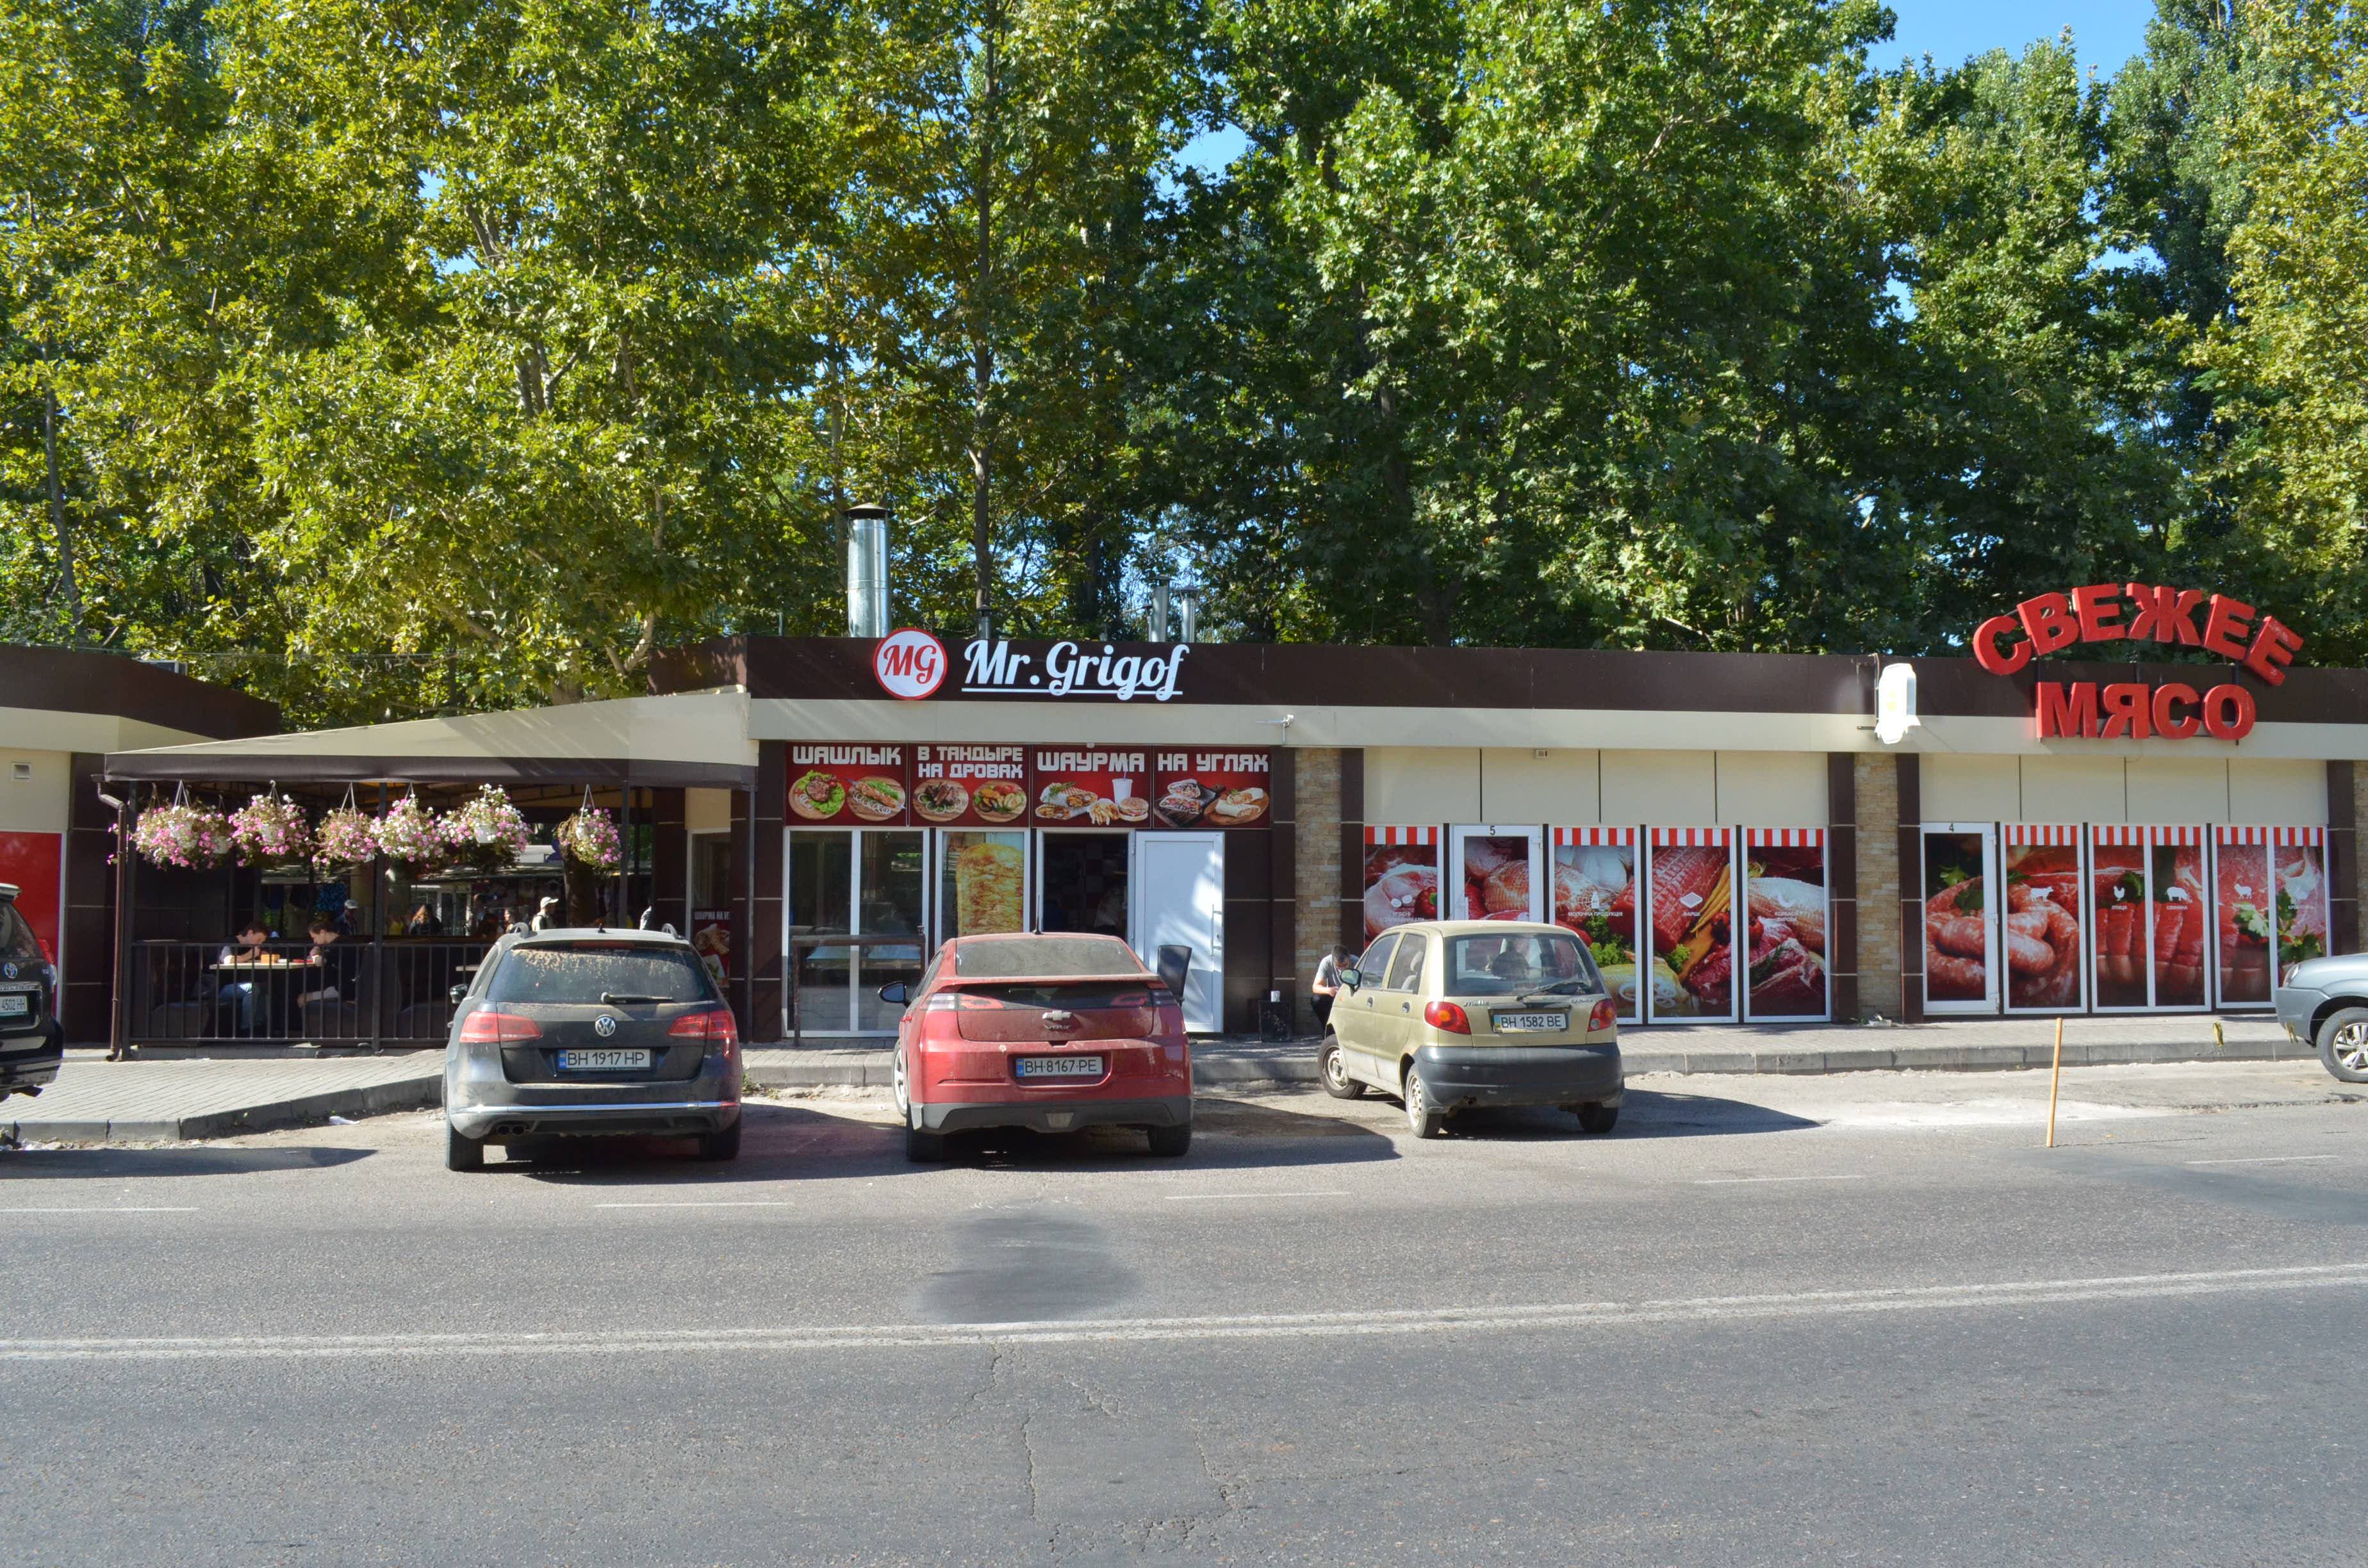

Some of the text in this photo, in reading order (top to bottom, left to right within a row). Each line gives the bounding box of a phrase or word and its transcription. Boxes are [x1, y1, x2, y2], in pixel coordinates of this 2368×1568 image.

[1973, 582, 2304, 686] СВЕЖЕЕ
[883, 644, 937, 685] MG
[964, 639, 1190, 701] Mr. Grigof
[2035, 682, 2256, 740] МЯСО
[793, 746, 901, 765] ШАШЛЫК
[917, 746, 1023, 762] В ТАНДЫРЕ
[1037, 752, 1145, 772] ШАУРМА
[1158, 753, 1269, 772] НА УГЛЯХ
[918, 763, 1023, 779] НА ДРОВАХ
[1490, 826, 1496, 835] 5
[1501, 1016, 1562, 1029] BH 1582 BE
[568, 1052, 645, 1066] BH 1917 HP
[1025, 1059, 1098, 1074] BH 8167 PE
